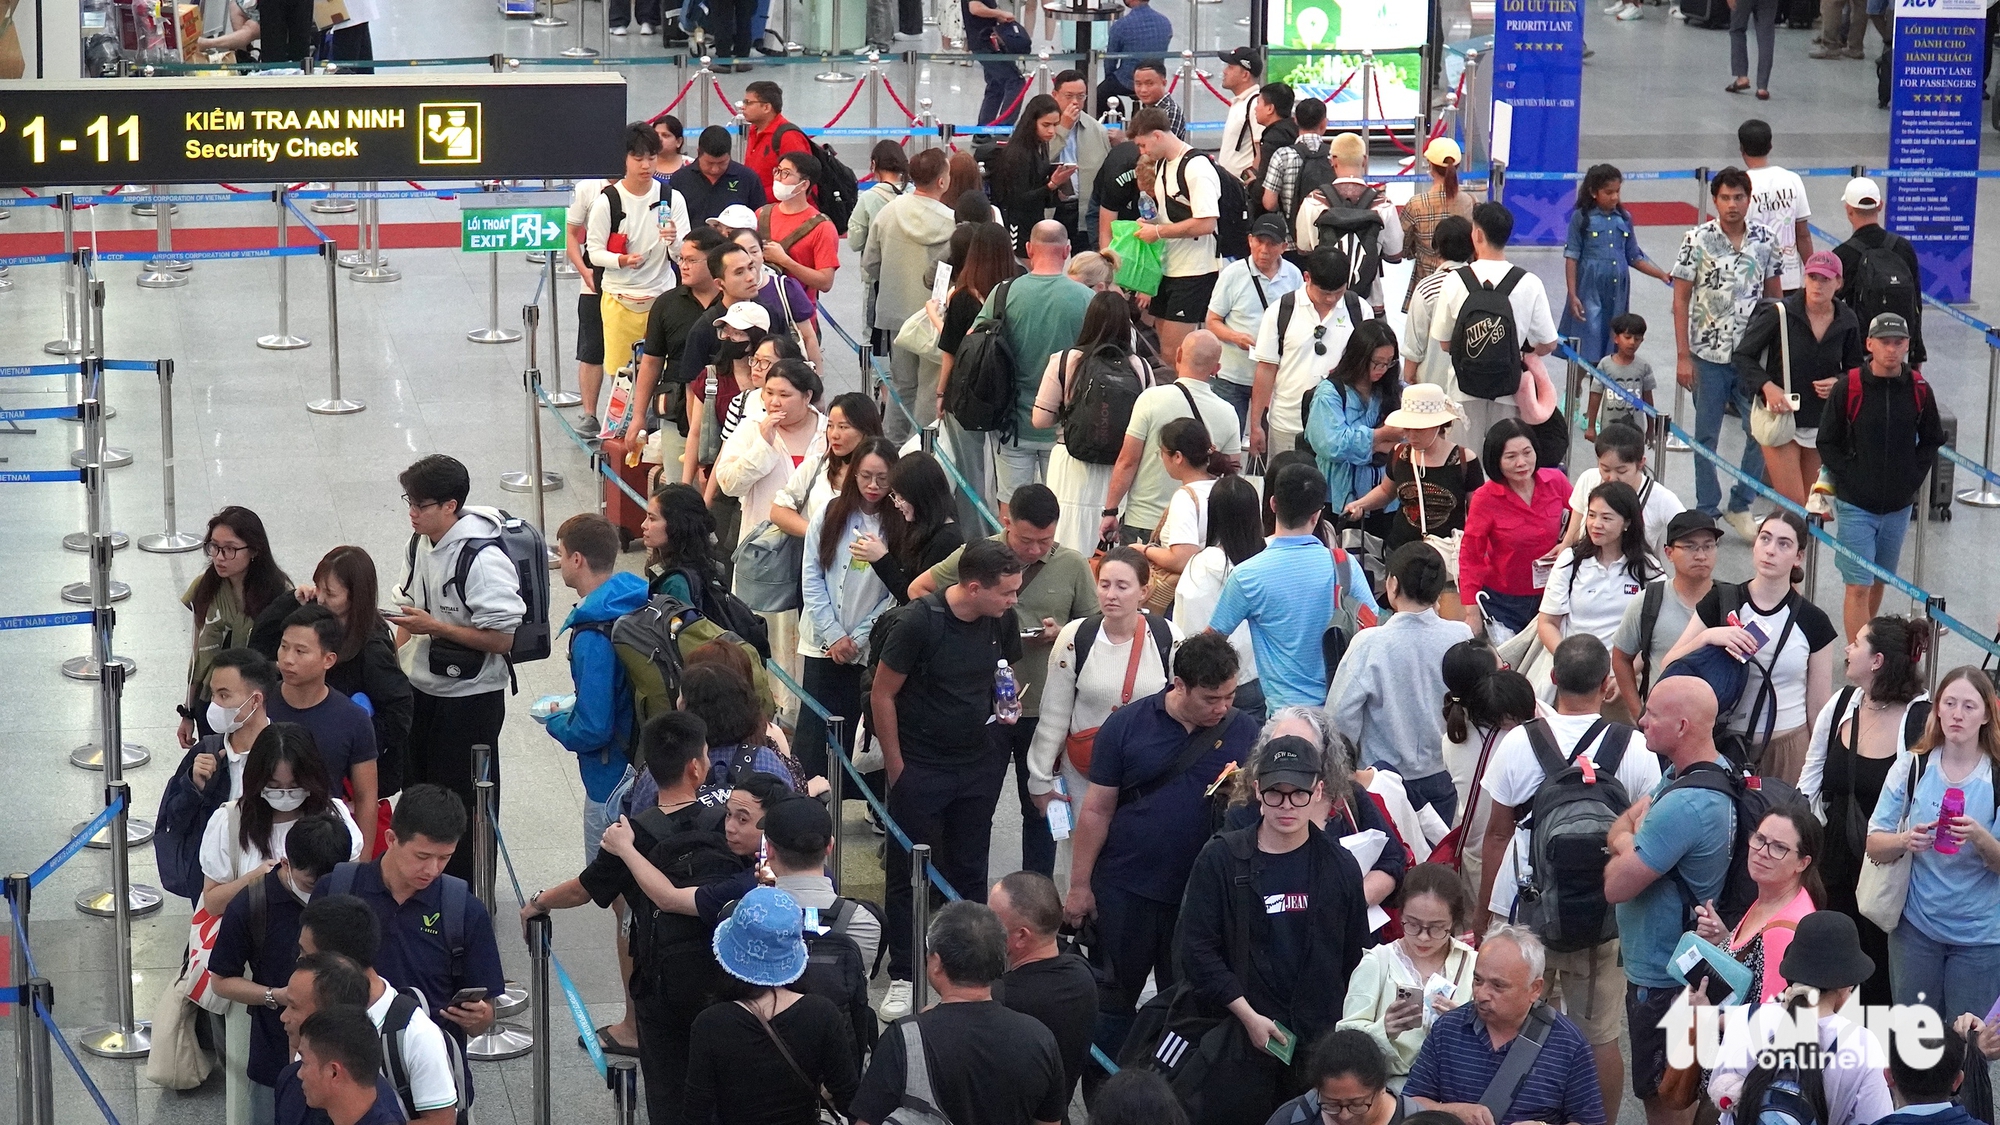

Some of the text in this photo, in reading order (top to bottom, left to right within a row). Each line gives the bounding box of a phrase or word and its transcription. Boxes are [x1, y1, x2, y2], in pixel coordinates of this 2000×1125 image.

[1506, 20, 1573, 31] PRIORITY LANE
[1945, 40, 1966, 48] CHO
[1507, 63, 1517, 71] VIP
[1905, 66, 1973, 75] PRIORITY LANE
[1900, 79, 1977, 88] FOR PASSENGERS
[185, 107, 405, 130] KIỂM TRA AN NINH
[185, 137, 359, 163] Security Check
[410, 190, 437, 198] VIETNAM
[1776, 188, 1797, 200] ALL
[467, 216, 510, 230] LỐI THOÁT
[470, 235, 507, 248] EXIT
[1466, 317, 1493, 345] NIKE
[1491, 324, 1506, 344] SB
[0, 368, 31, 376] VIETNAM
[25, 617, 47, 626] NAM
[54, 615, 78, 625] CTCP
[1273, 751, 1287, 762] NEW
